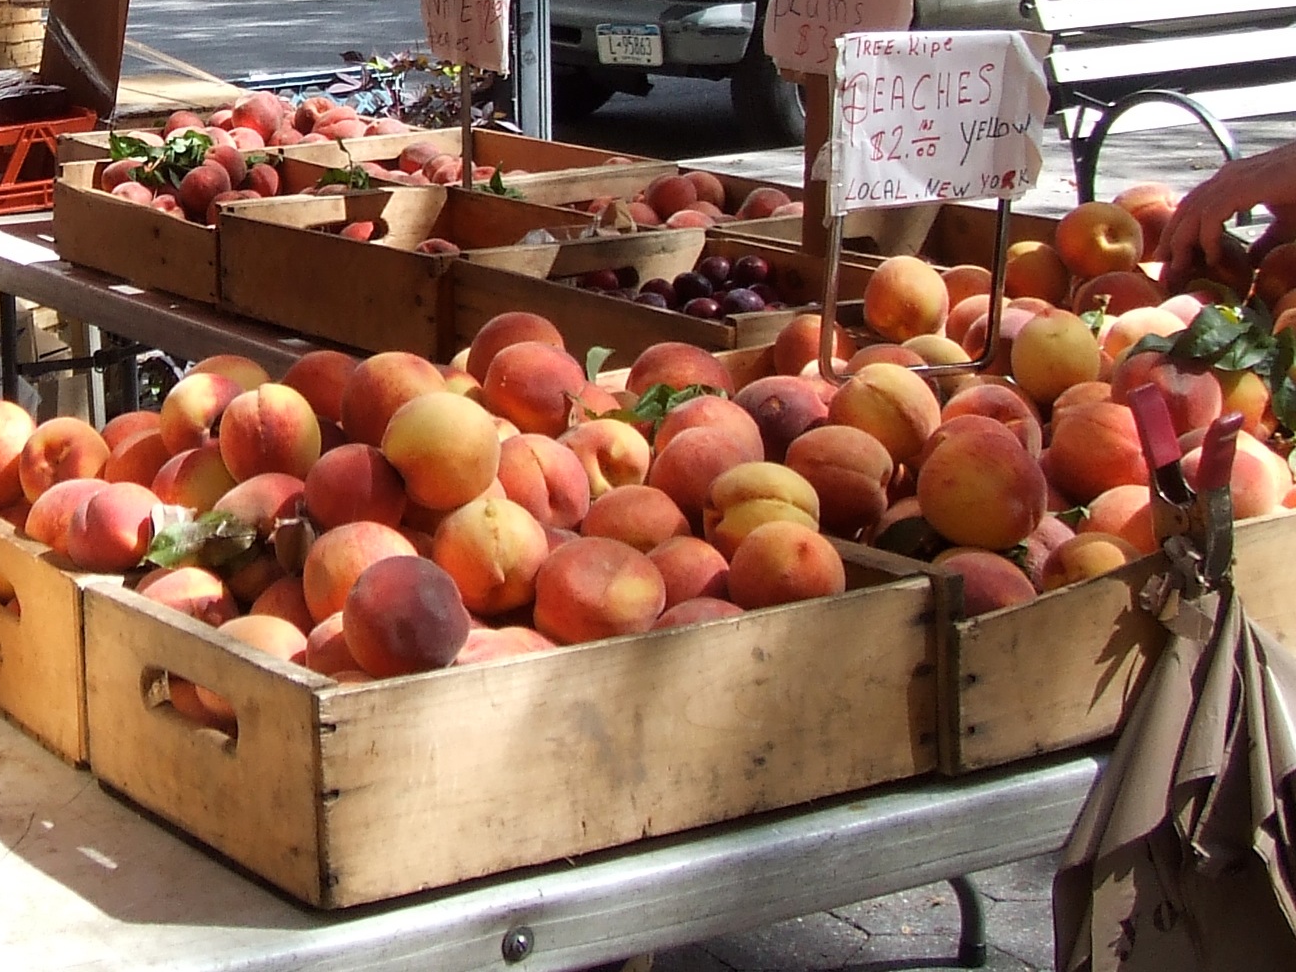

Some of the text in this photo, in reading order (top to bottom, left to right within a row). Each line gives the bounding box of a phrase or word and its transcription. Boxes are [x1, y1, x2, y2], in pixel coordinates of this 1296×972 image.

[841, 63, 996, 148] PEACHES
[925, 177, 970, 199] NEW
[980, 168, 1030, 193] YORK
